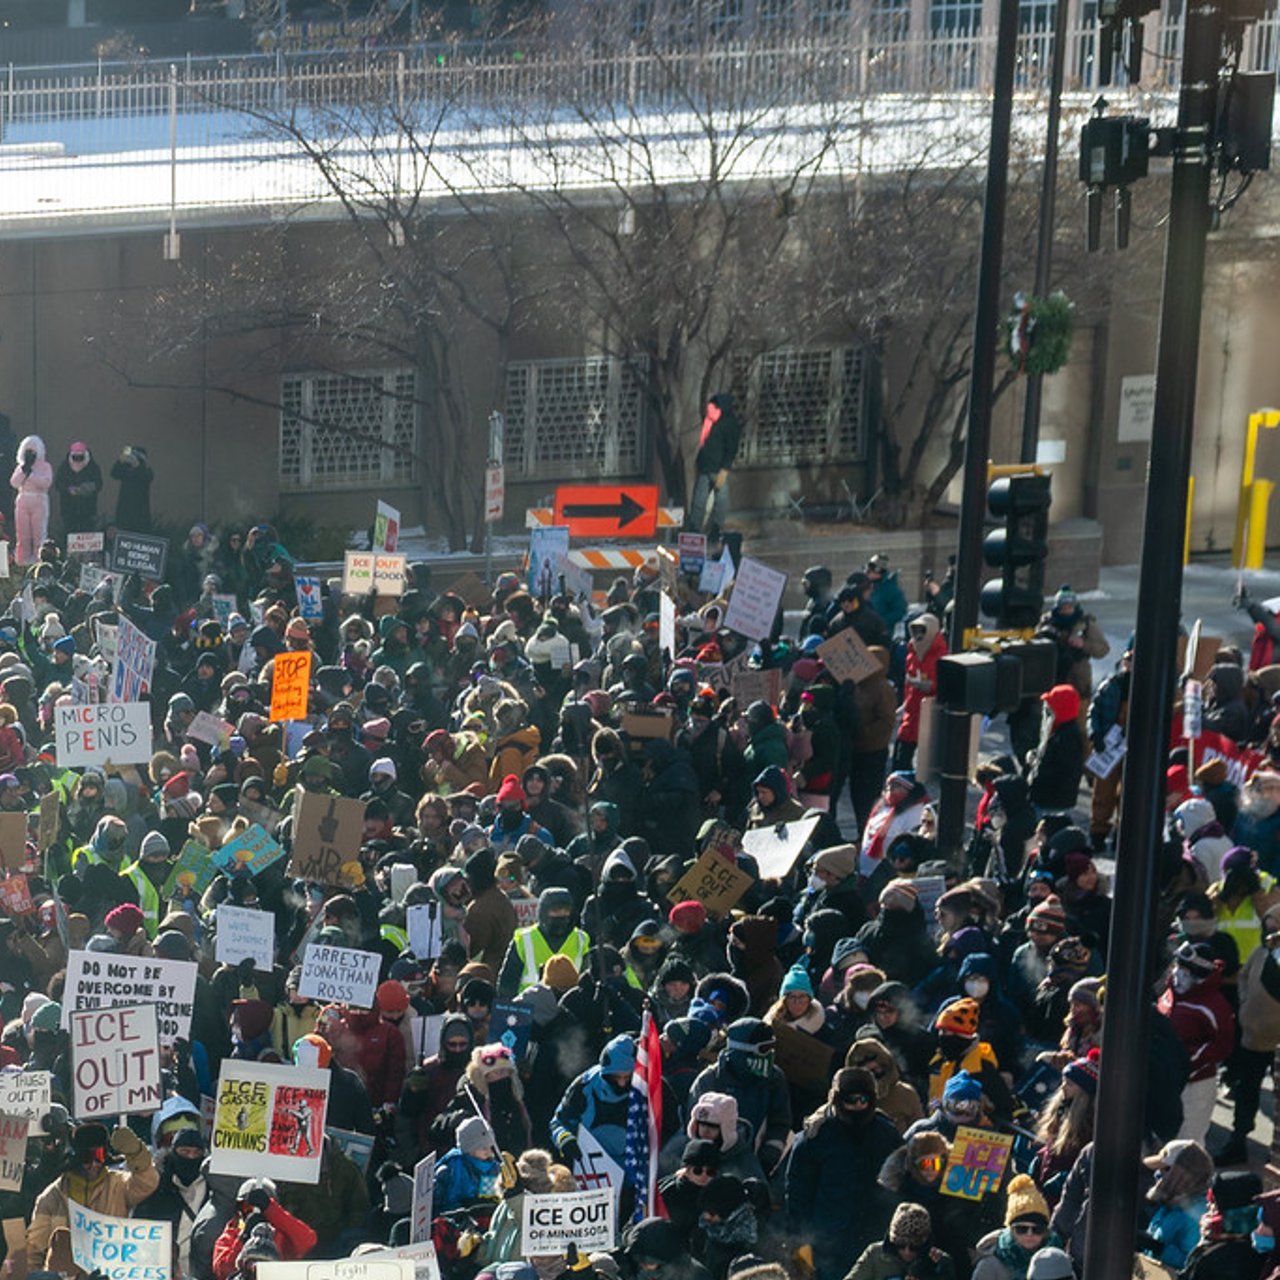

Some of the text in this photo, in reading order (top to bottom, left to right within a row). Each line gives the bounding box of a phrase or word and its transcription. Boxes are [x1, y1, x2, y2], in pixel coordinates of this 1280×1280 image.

[274, 656, 308, 679] STOP
[62, 705, 126, 725] MICRO
[66, 725, 137, 752] PENIS
[312, 949, 371, 968] ARREST
[82, 962, 162, 982] DO NOT BE
[305, 964, 374, 986] JONATHAN
[77, 981, 176, 999] OVERCOME BY
[317, 982, 354, 1001] ROSS
[76, 1011, 140, 1048] ICE
[76, 1050, 154, 1090] OUT
[85, 1085, 160, 1113] OF MN
[964, 1144, 1005, 1170] ICE
[949, 1169, 999, 1199] OUT
[530, 1203, 607, 1226] ICE OUT
